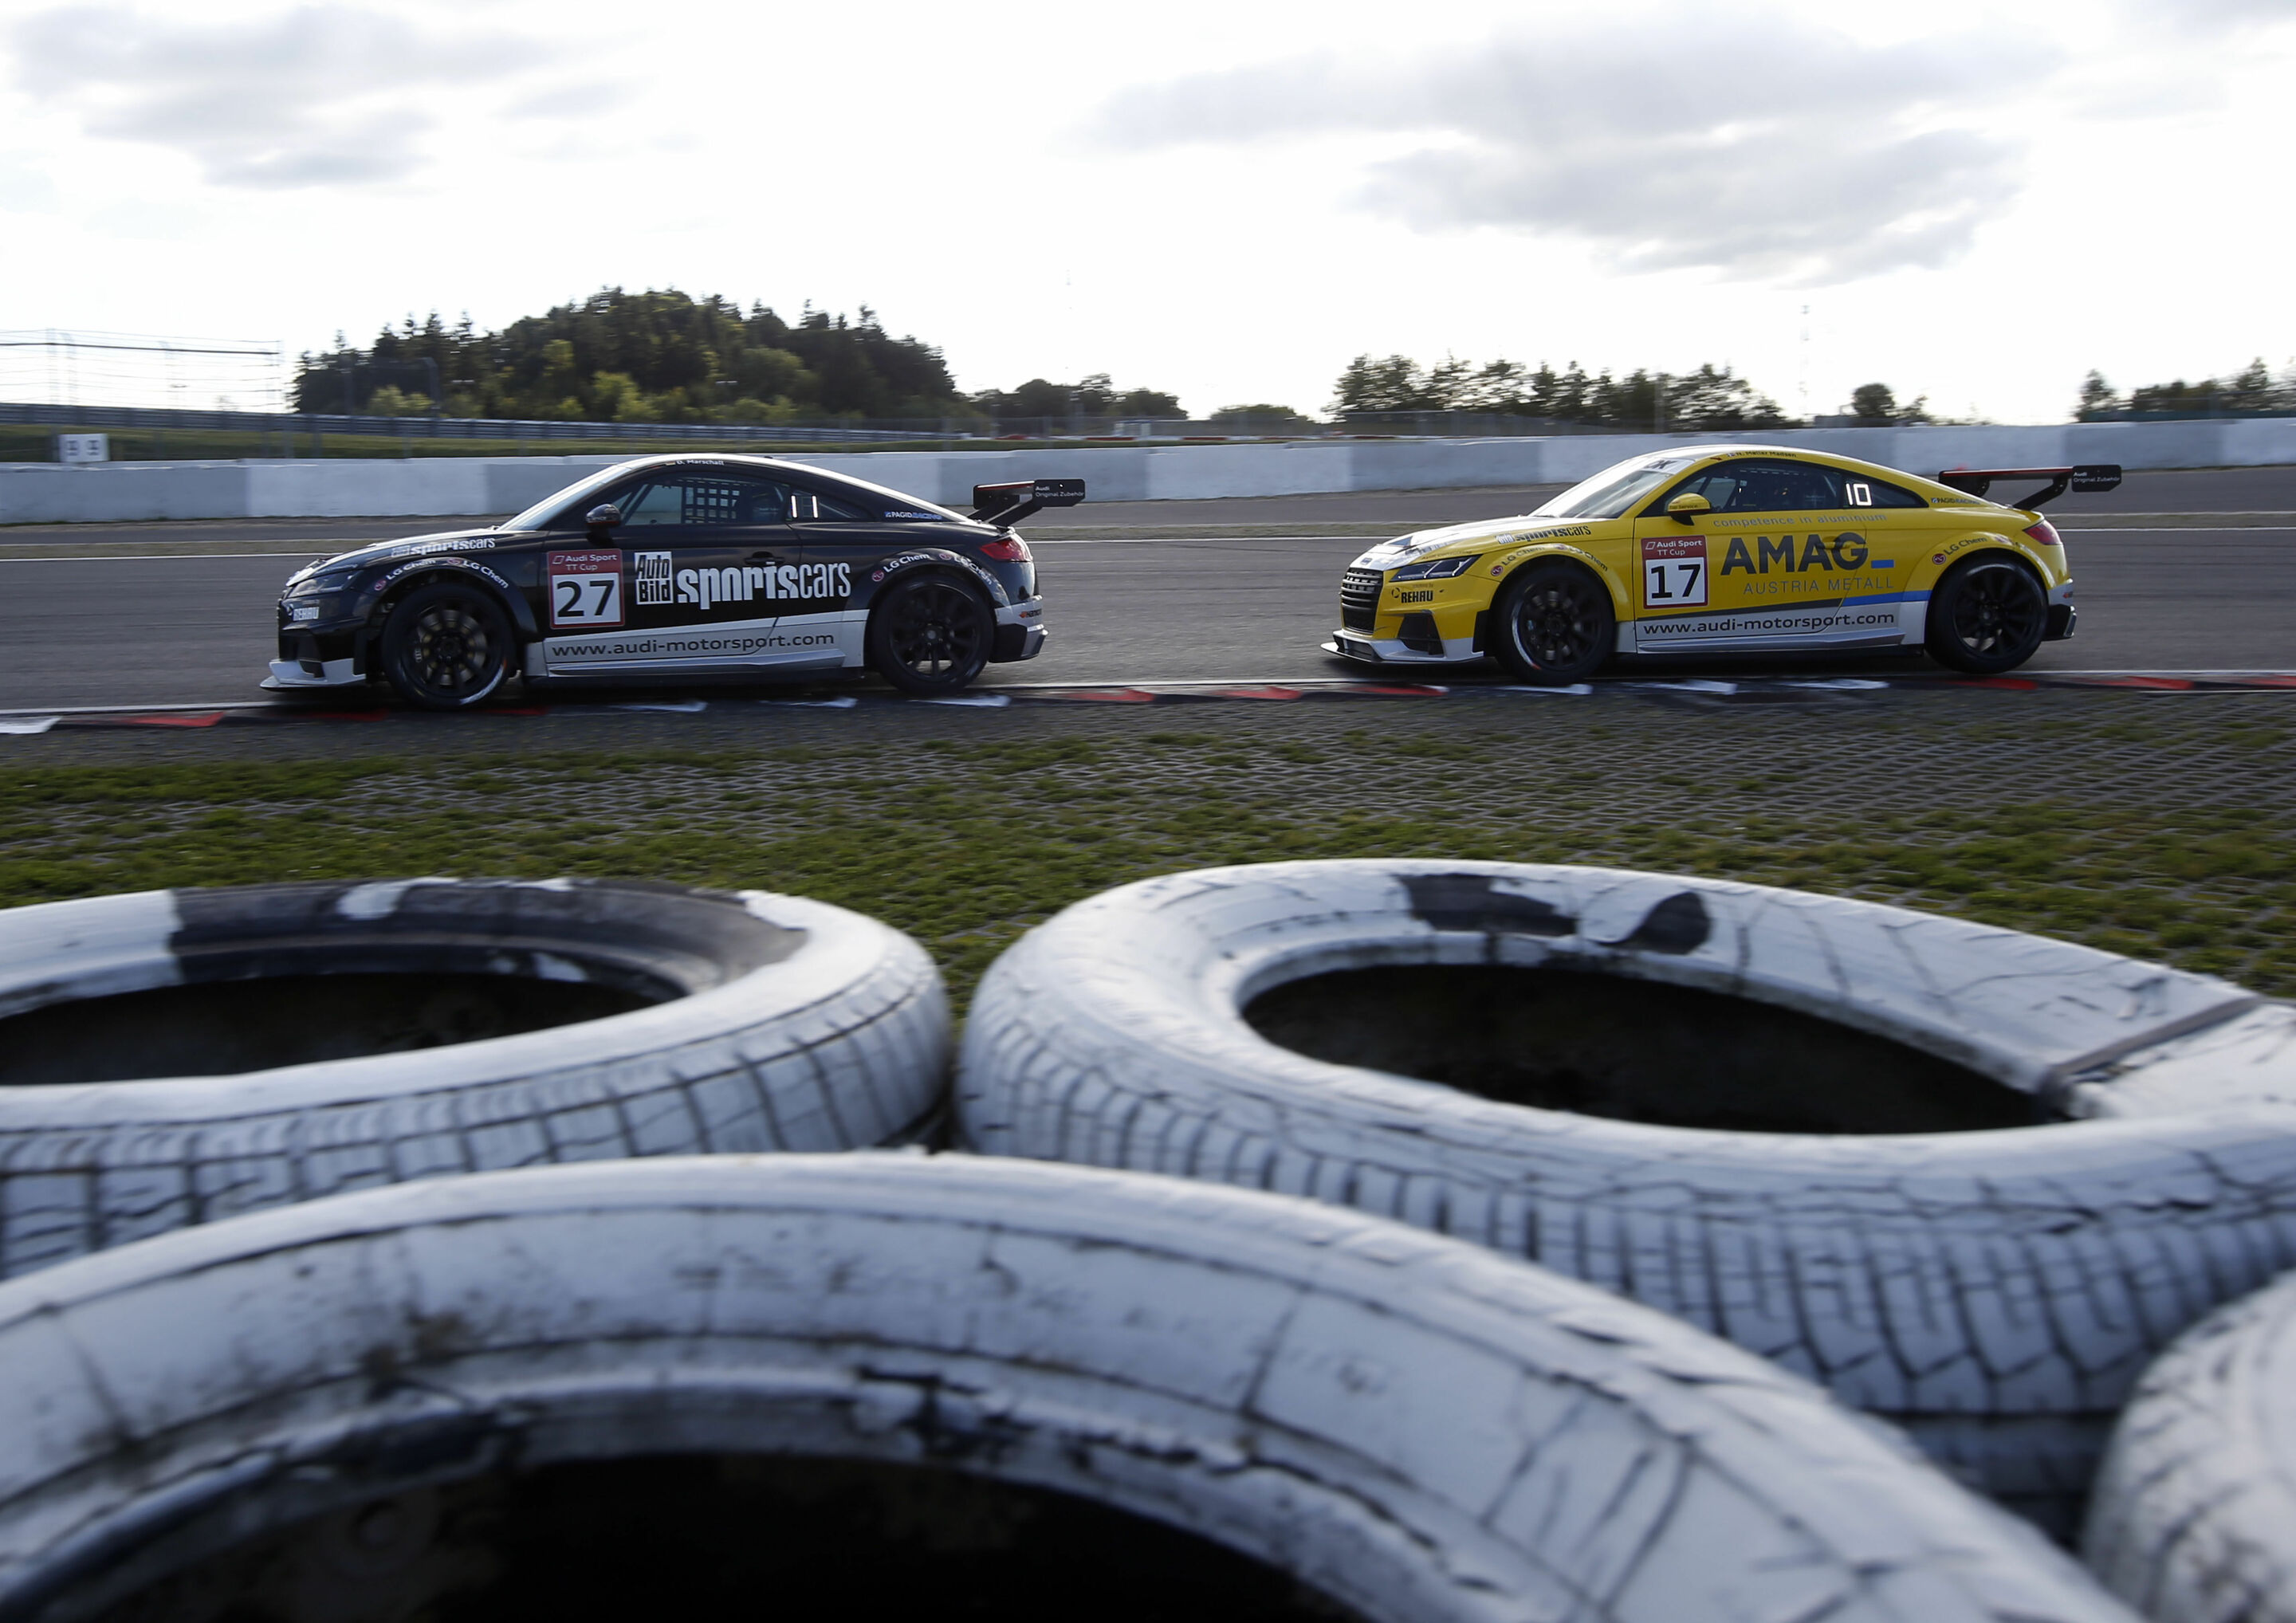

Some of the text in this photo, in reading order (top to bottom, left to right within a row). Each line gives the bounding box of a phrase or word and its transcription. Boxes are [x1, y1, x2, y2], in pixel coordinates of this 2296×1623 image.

[1846, 482, 1873, 507] 10
[1713, 513, 1887, 528] competence in aluminium
[1516, 525, 1591, 542] sportscars
[1677, 540, 1703, 548] Sport
[411, 537, 495, 555] sportscars
[1502, 546, 1545, 566] LG Chem
[1720, 532, 1869, 576] AMAG
[1944, 536, 1987, 556] LG Chem
[579, 564, 598, 572] Cup
[589, 553, 617, 563] Sport
[637, 555, 671, 580] Auto
[883, 552, 930, 573] LG Chem
[1584, 551, 1608, 572] Chem
[387, 558, 437, 581] LG Chem
[462, 560, 510, 589] LG Chem
[639, 580, 672, 603] Bild
[678, 561, 851, 610] sportscars
[1650, 564, 1700, 599] 17
[1744, 576, 1895, 595] AUSTRIA METALL
[557, 580, 615, 618] 27
[1401, 590, 1434, 604] REHAU
[1643, 612, 1894, 635] www.audi-motorsport.com
[552, 633, 835, 657] www.audi-motorsport.com
